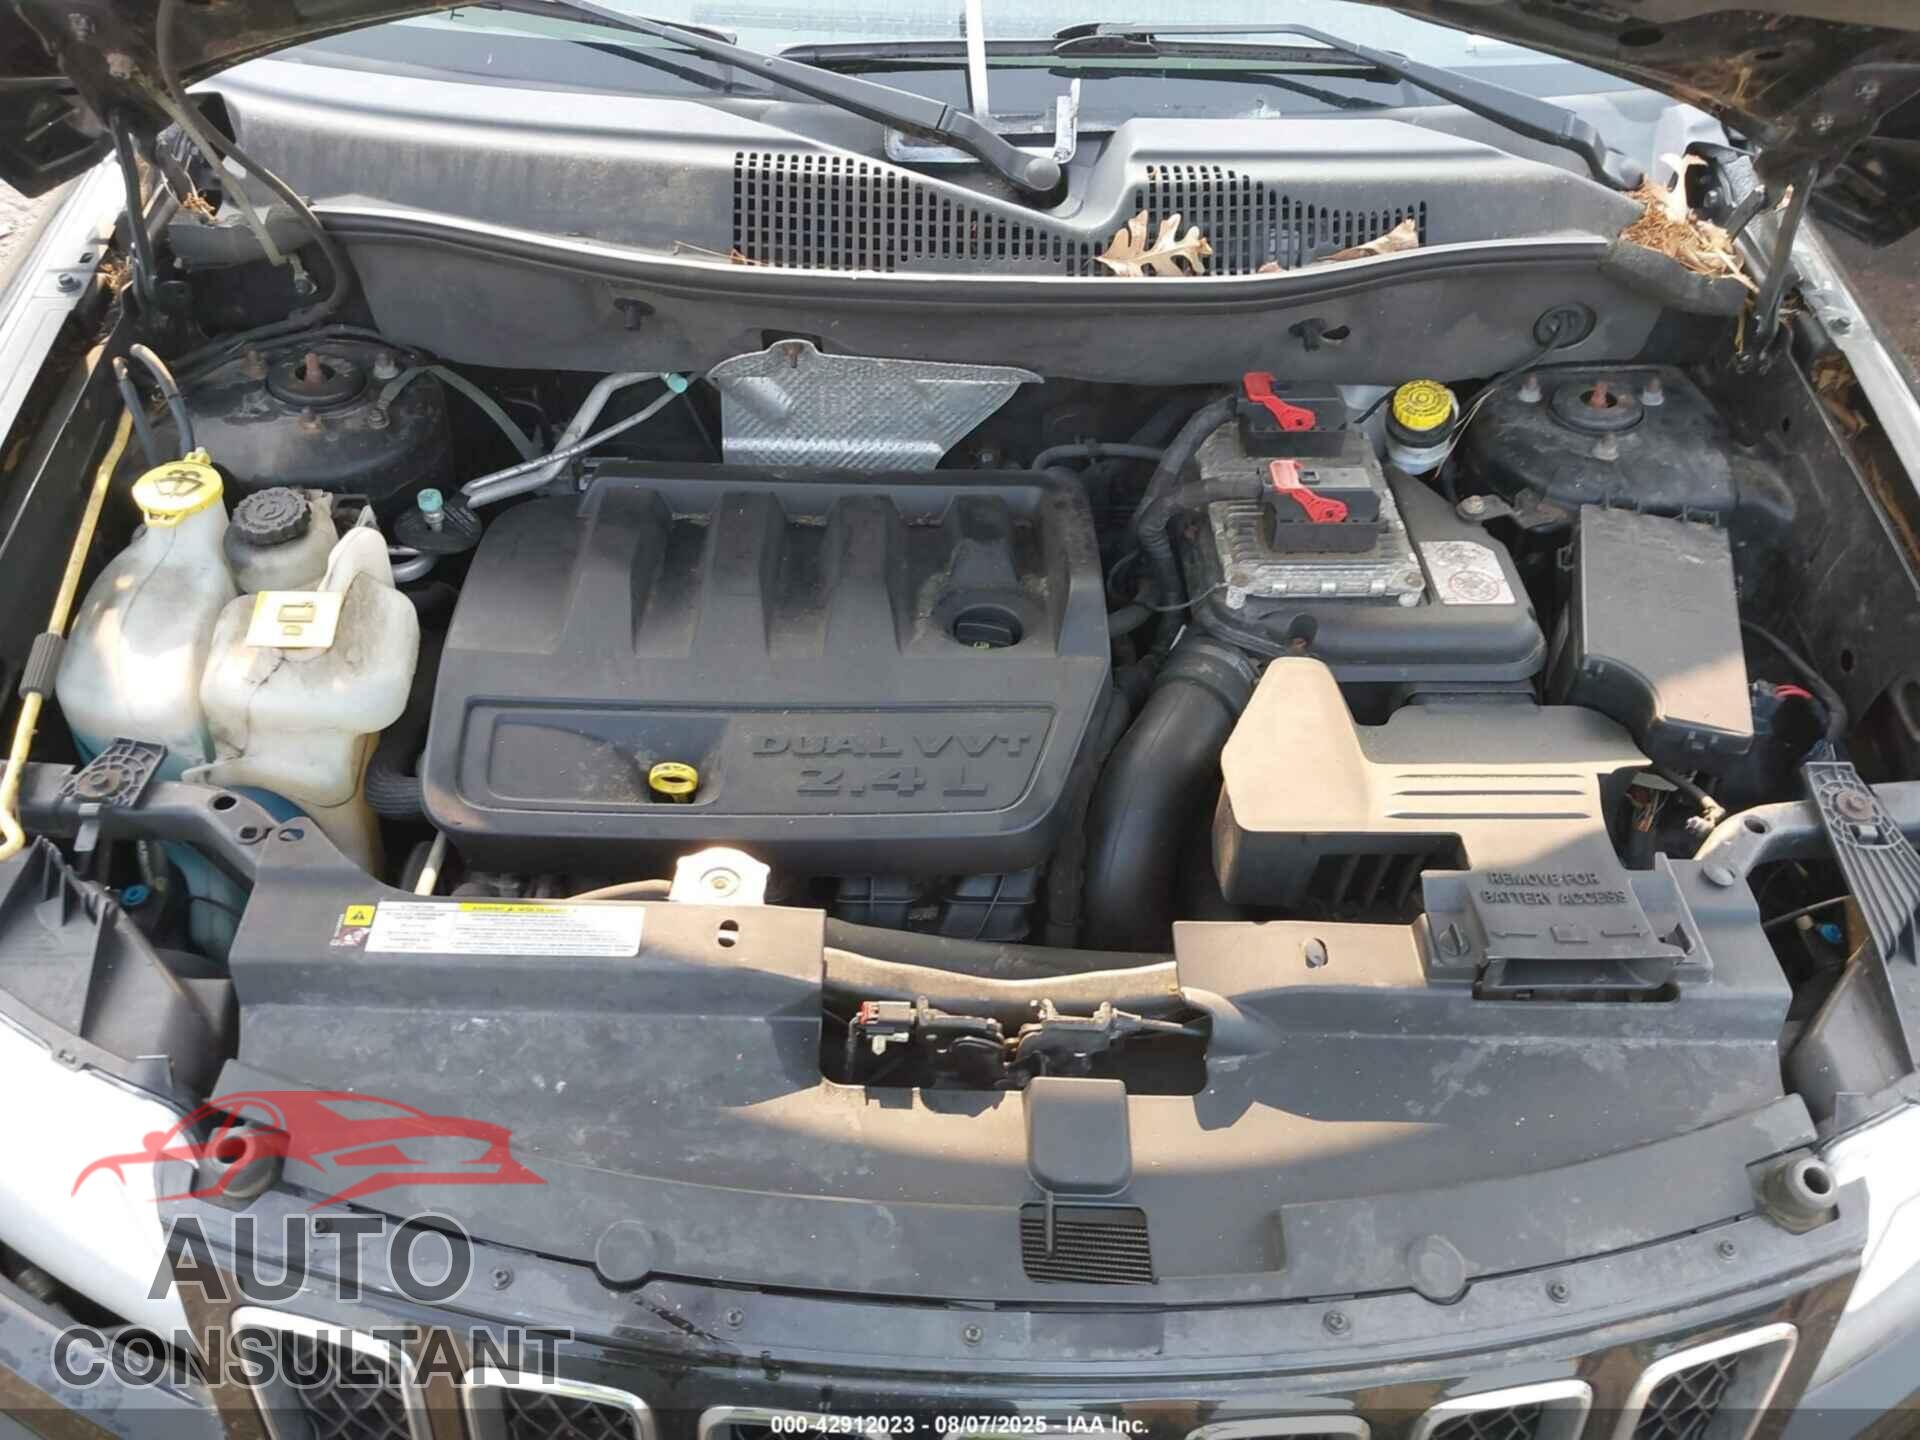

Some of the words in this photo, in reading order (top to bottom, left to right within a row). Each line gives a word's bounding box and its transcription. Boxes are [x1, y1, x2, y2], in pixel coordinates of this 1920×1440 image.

[752, 734, 904, 758] DUAL
[913, 733, 1032, 758] VVT
[1488, 872, 1561, 886] REMOVE
[1564, 872, 1600, 886] FOR
[1481, 890, 1552, 906] BATTERY
[1560, 890, 1627, 905] ACCESS
